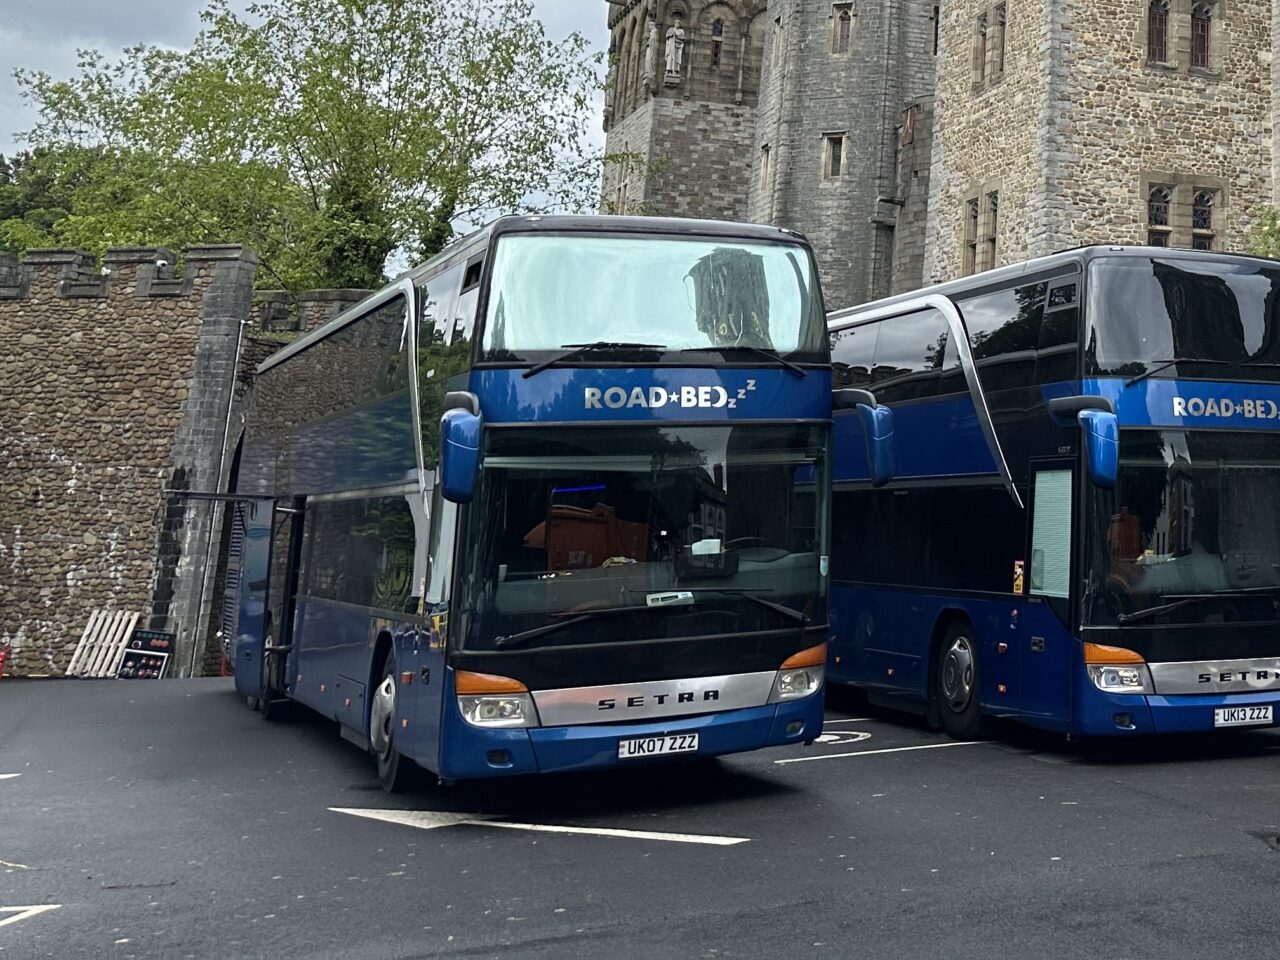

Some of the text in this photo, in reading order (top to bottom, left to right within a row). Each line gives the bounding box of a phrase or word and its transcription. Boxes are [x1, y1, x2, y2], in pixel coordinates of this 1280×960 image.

[585, 386, 668, 409] ROAD
[1173, 397, 1235, 417] ROAD
[598, 690, 719, 711] SETRA
[1223, 707, 1269, 722] UK13 ZZZ
[628, 735, 696, 755] UK07 ZZZ
